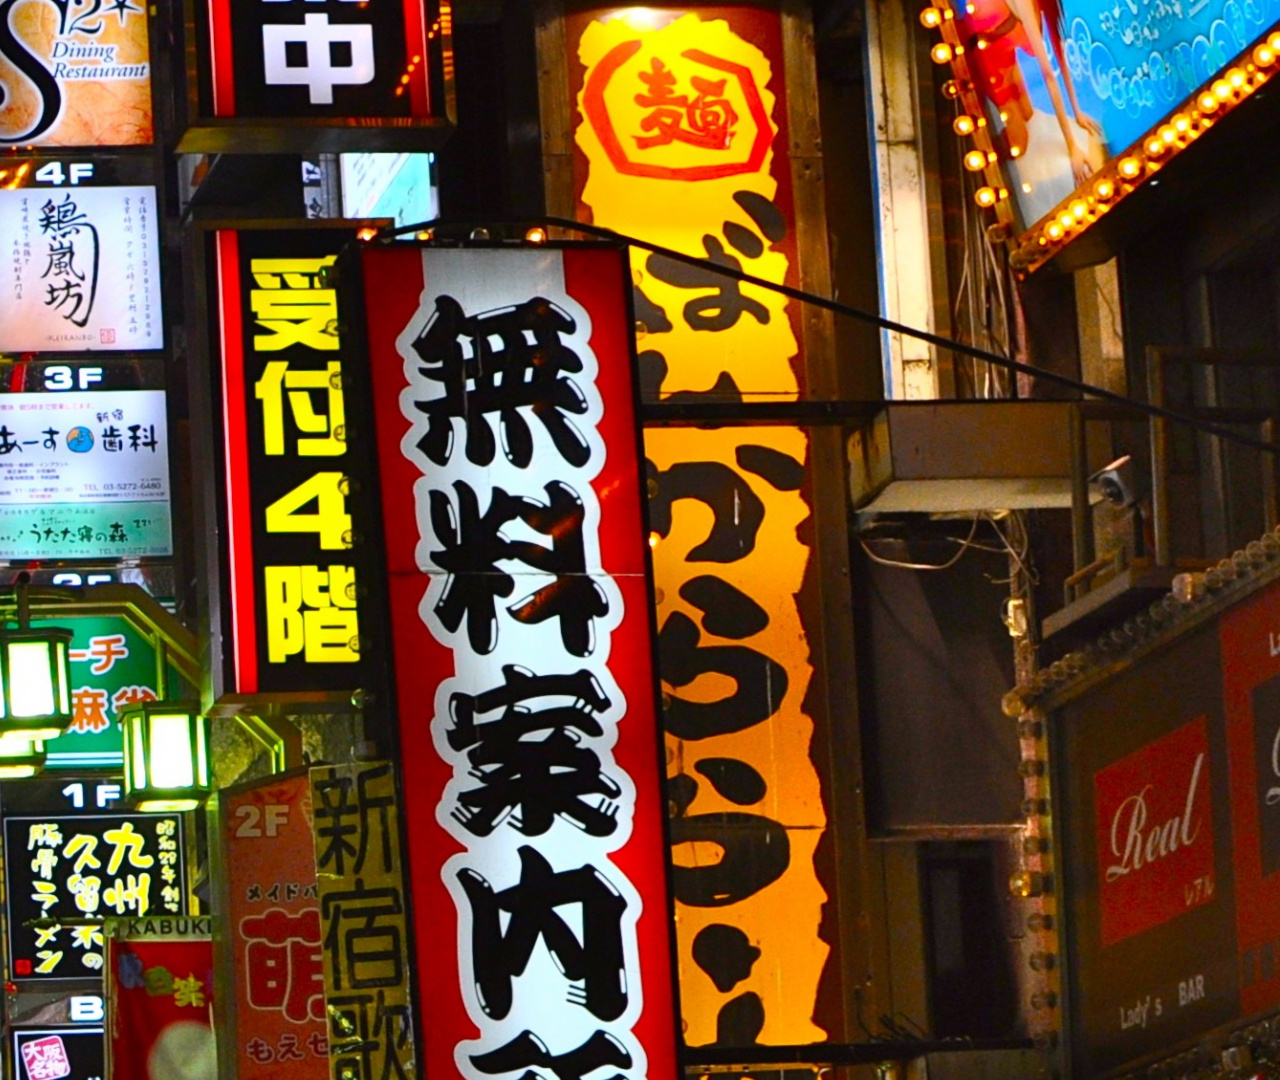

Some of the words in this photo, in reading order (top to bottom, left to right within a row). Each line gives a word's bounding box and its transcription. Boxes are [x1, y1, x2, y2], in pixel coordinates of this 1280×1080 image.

[51, 41, 116, 64] Dining
[53, 61, 148, 80] Restaurant
[35, 161, 94, 185] 4F
[43, 366, 102, 390] 3F
[101, 424, 158, 452] 歯科
[251, 255, 361, 663] 受付4階
[61, 784, 120, 807] 1F
[235, 806, 288, 839] 2F
